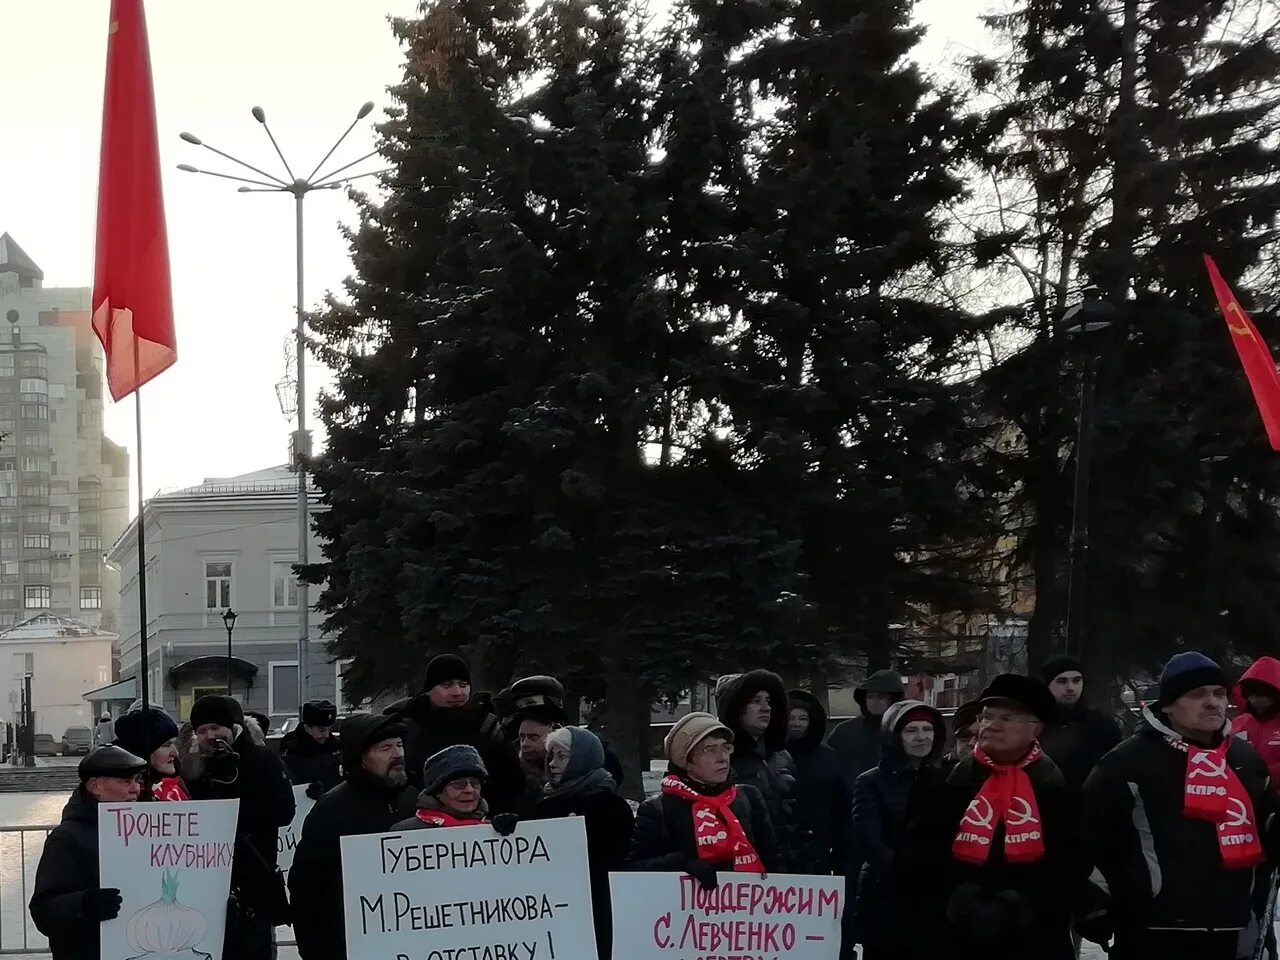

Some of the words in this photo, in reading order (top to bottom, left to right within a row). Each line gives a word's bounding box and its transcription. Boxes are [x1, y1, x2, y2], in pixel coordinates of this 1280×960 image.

[1186, 784, 1227, 796] КПРФ
[107, 806, 200, 847] ТРОНЕТЕ
[1221, 833, 1254, 846] КПРФ
[150, 842, 235, 869] КЛУБНИКУ
[380, 835, 550, 874] ГУБЕРНАТОРА
[679, 874, 839, 919] ПОДДЕРЖИМ
